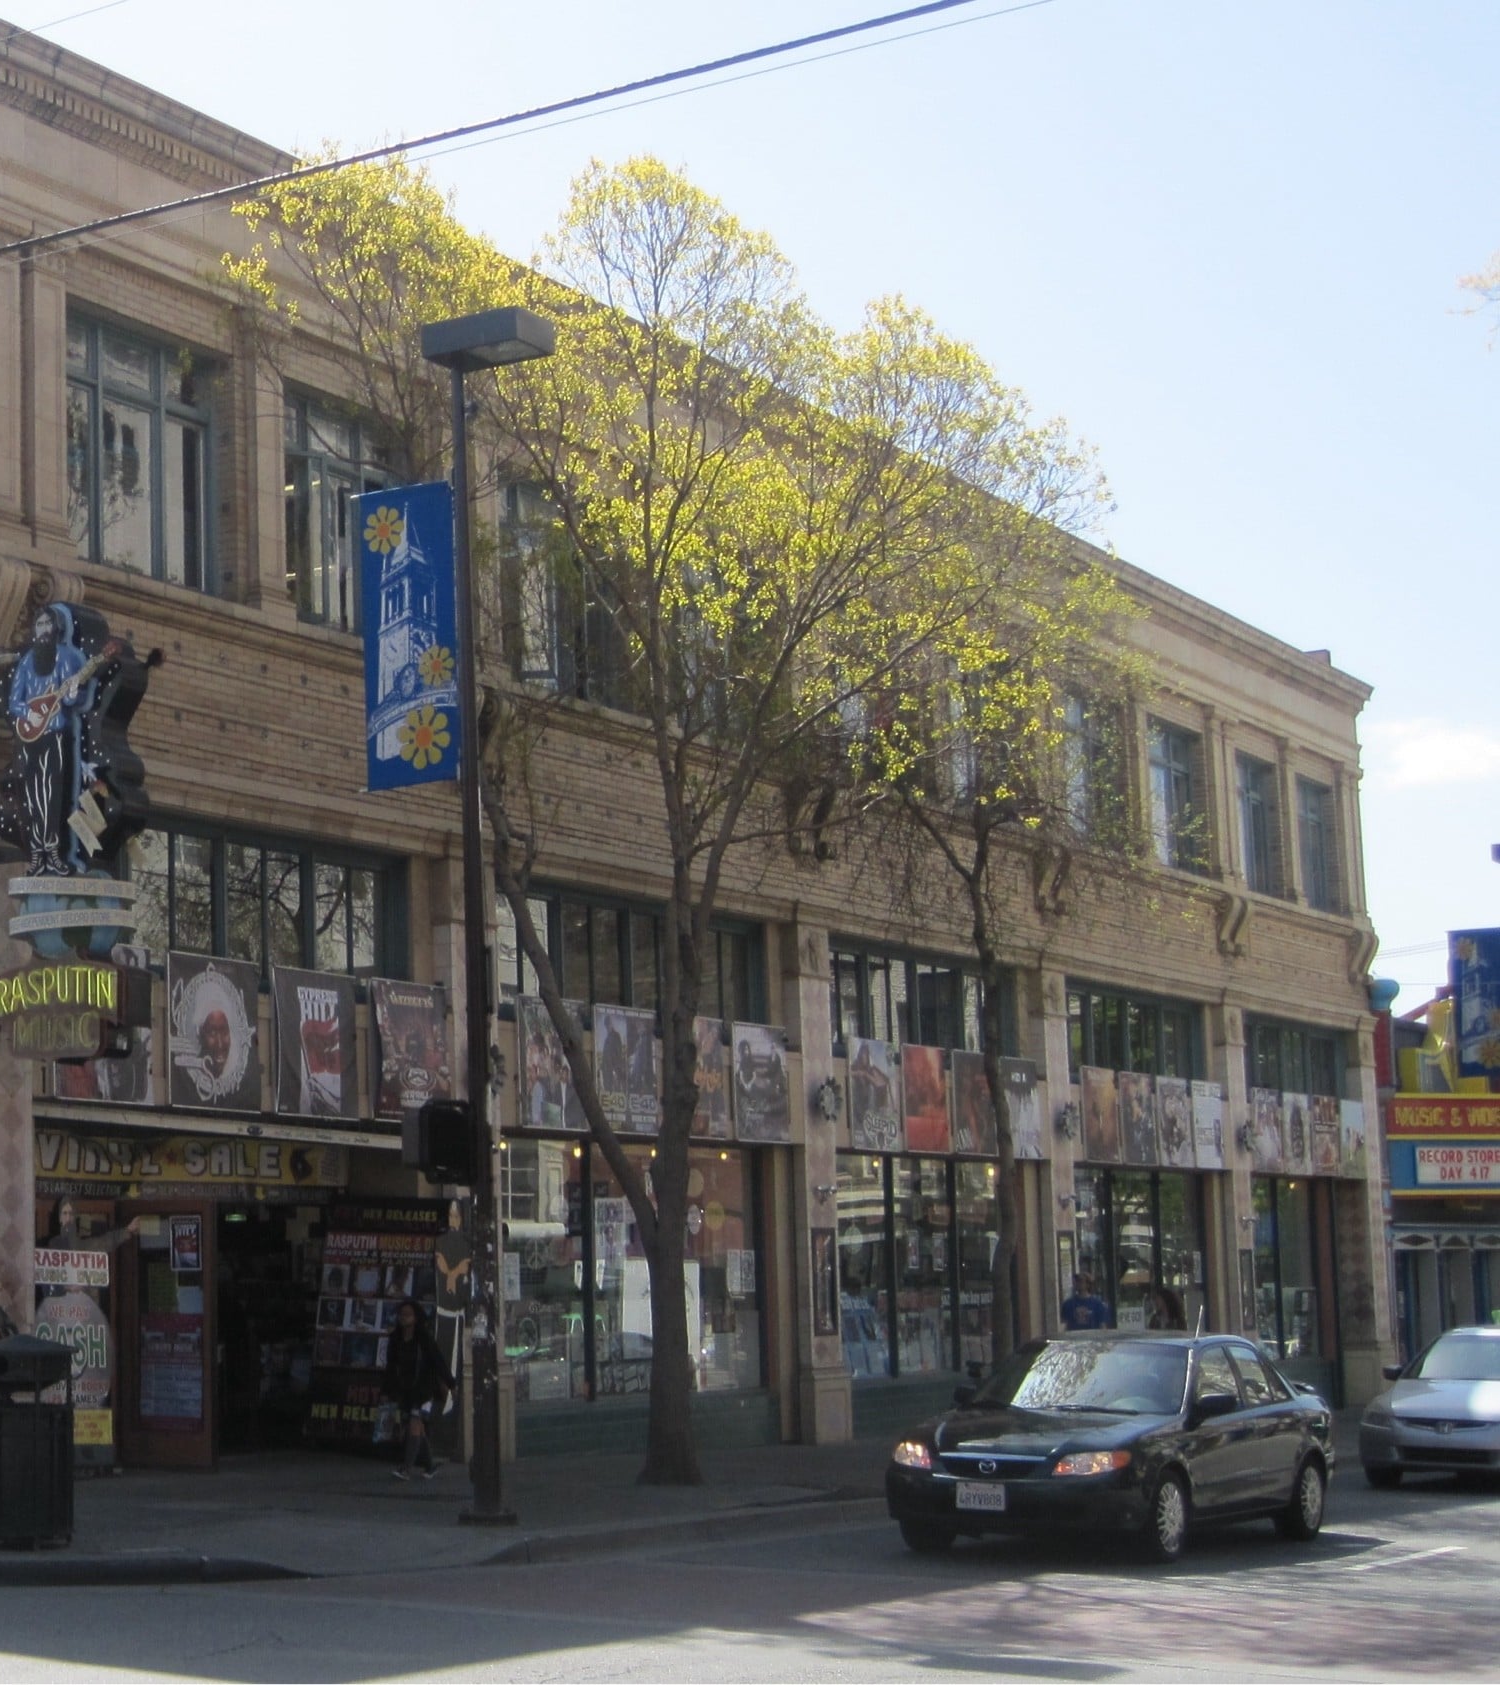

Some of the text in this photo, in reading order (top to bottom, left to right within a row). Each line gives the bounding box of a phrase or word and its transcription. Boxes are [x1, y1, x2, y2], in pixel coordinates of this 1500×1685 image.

[12, 1010, 102, 1050] MUSIC
[1394, 1105, 1444, 1128] MUSIC
[1450, 1107, 1461, 1128] &
[183, 1140, 283, 1178] SALE
[1419, 1151, 1500, 1163] RECORD STORE
[1440, 1167, 1463, 1180] DAY
[386, 1208, 438, 1222] RELEASES
[326, 1232, 378, 1250] RASPUTIN
[378, 1234, 411, 1251] MUSIC
[35, 1250, 107, 1270] RASPUTIN
